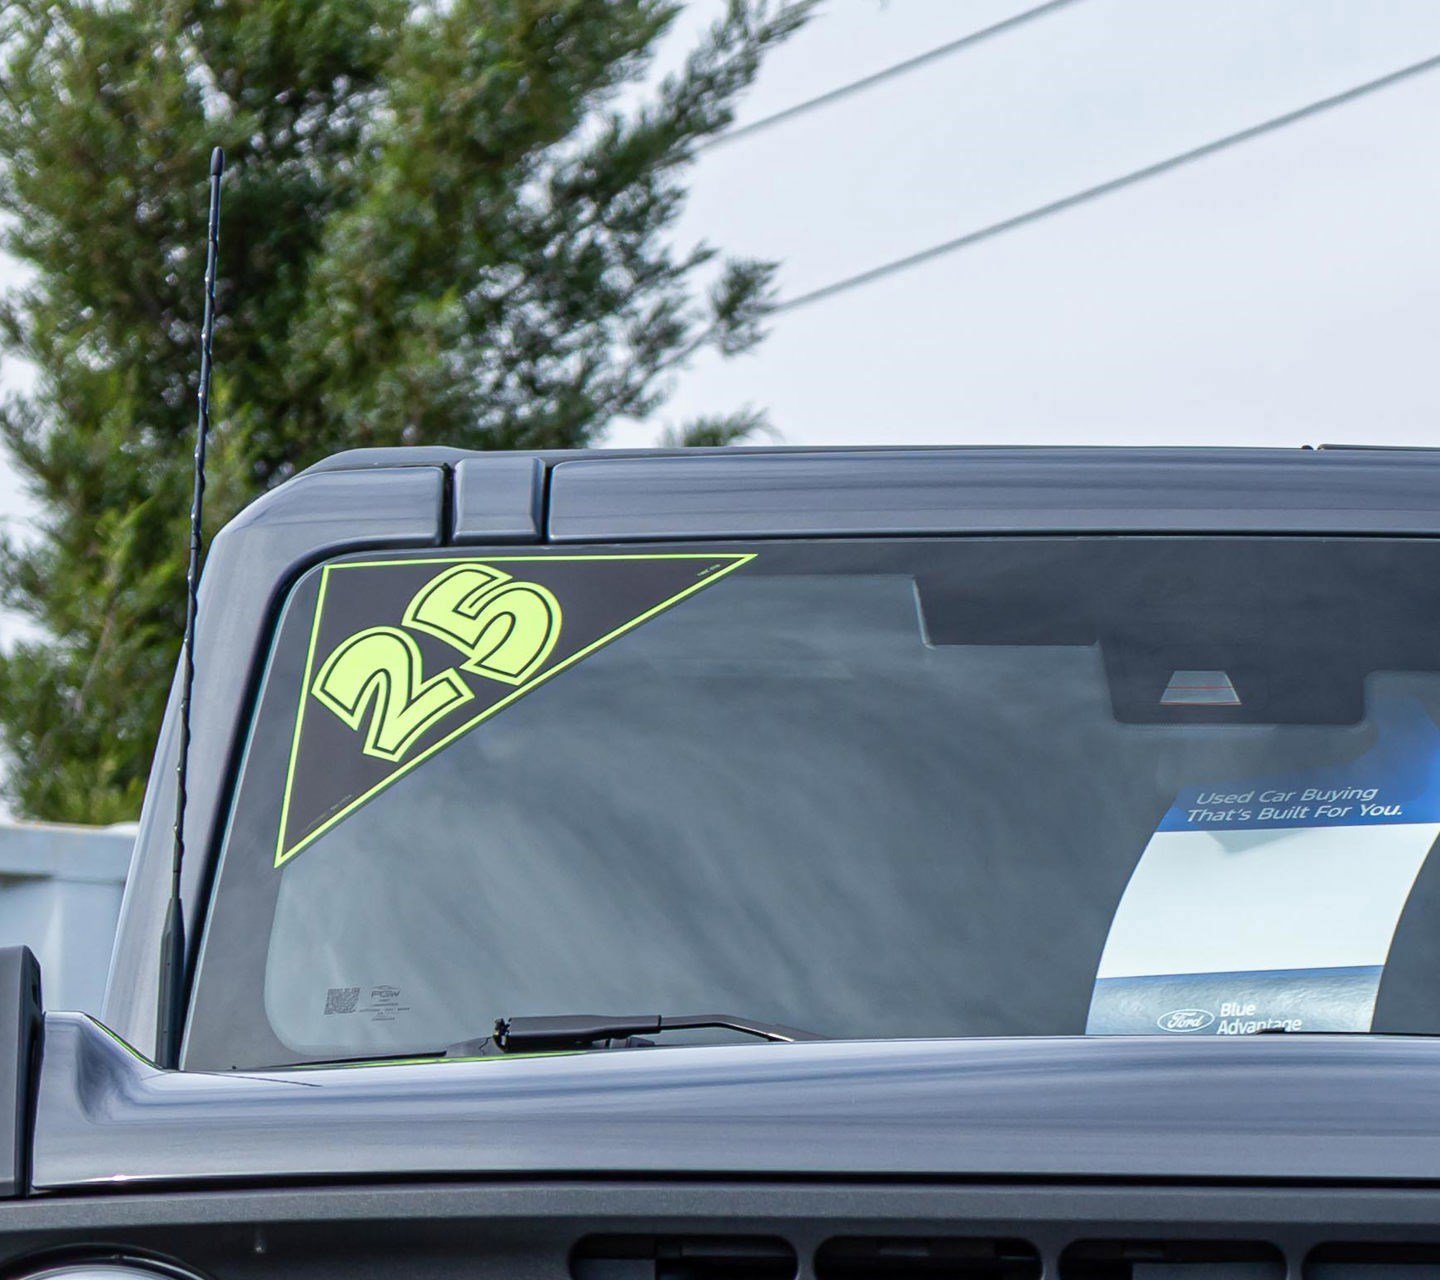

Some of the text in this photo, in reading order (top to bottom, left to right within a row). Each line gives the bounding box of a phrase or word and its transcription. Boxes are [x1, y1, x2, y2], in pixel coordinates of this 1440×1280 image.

[311, 563, 562, 762] 25
[1196, 786, 1379, 805] Used Car Buying
[1257, 806, 1310, 821] Built
[1314, 804, 1352, 819] For
[1360, 802, 1403, 817] You.
[1220, 1002, 1257, 1017] Blue
[1216, 1018, 1303, 1035] Advantage
